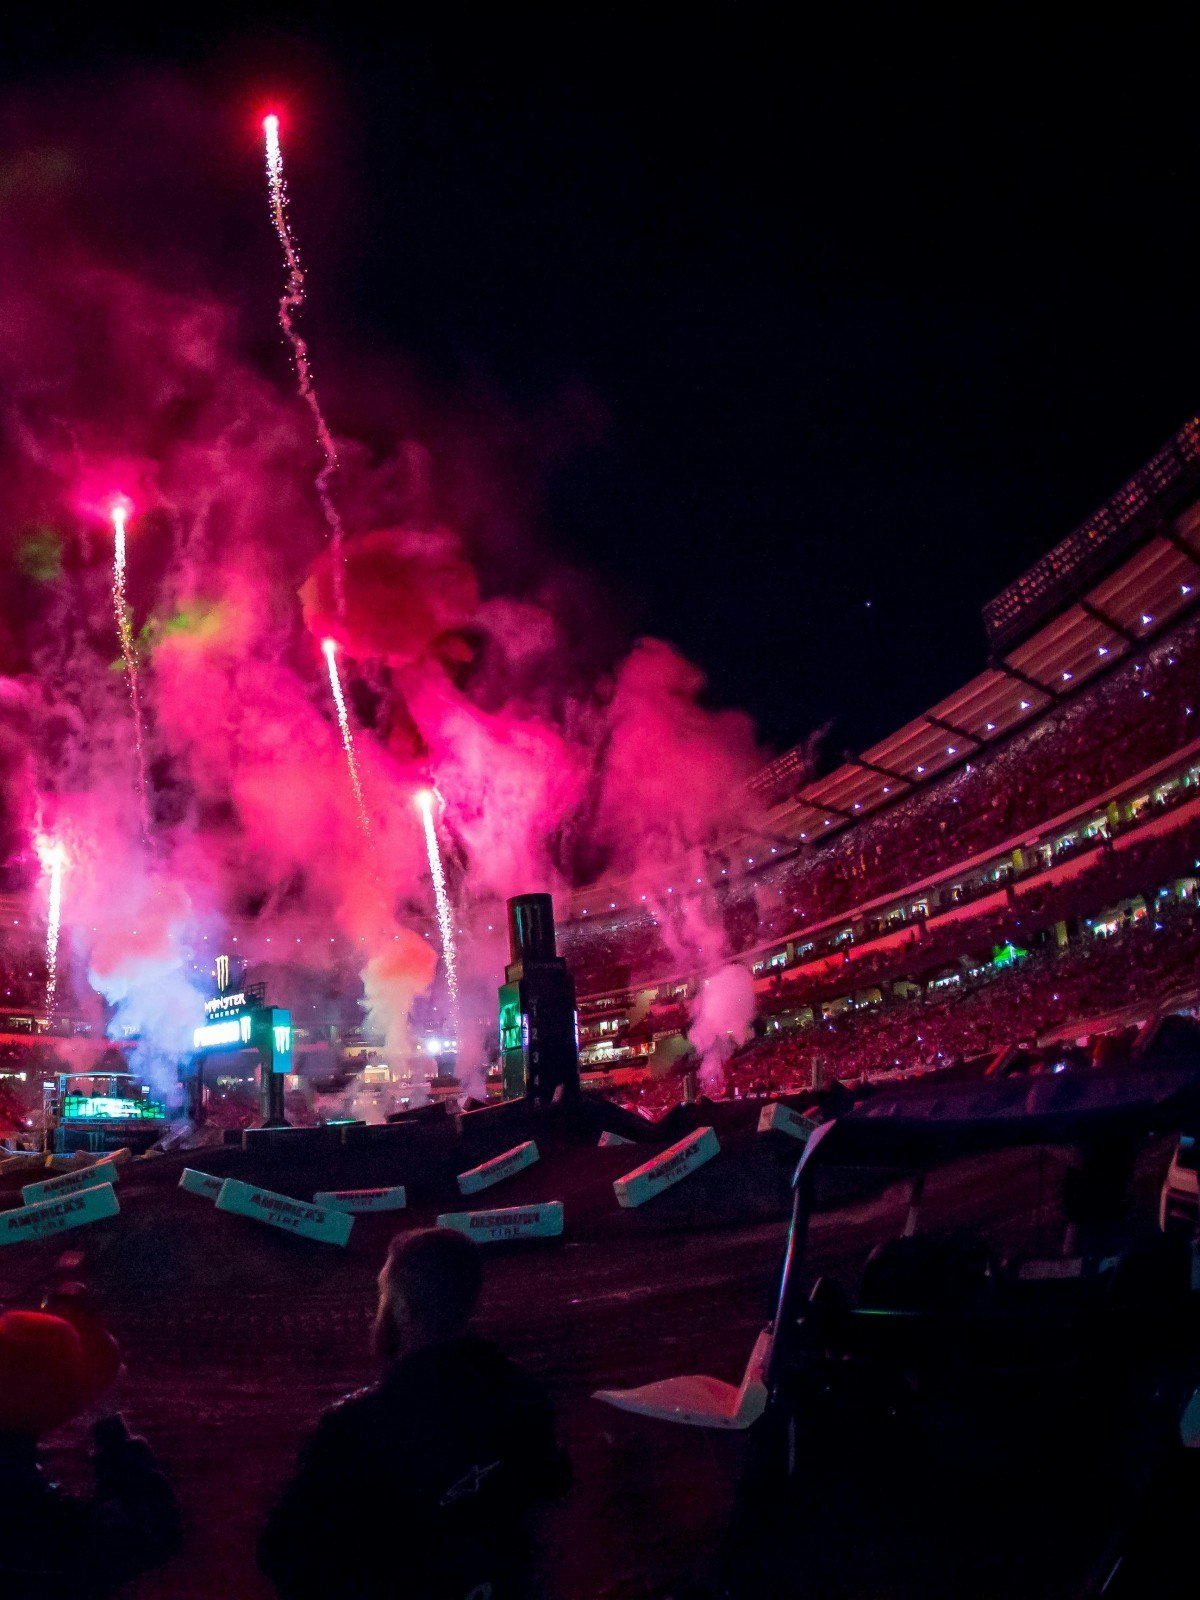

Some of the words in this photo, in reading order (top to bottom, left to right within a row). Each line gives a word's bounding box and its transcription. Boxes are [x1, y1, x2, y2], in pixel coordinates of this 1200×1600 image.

[204, 993, 246, 1013] MONSTER
[267, 1212, 300, 1228] TIRE
[490, 1227, 521, 1238] TIRE
